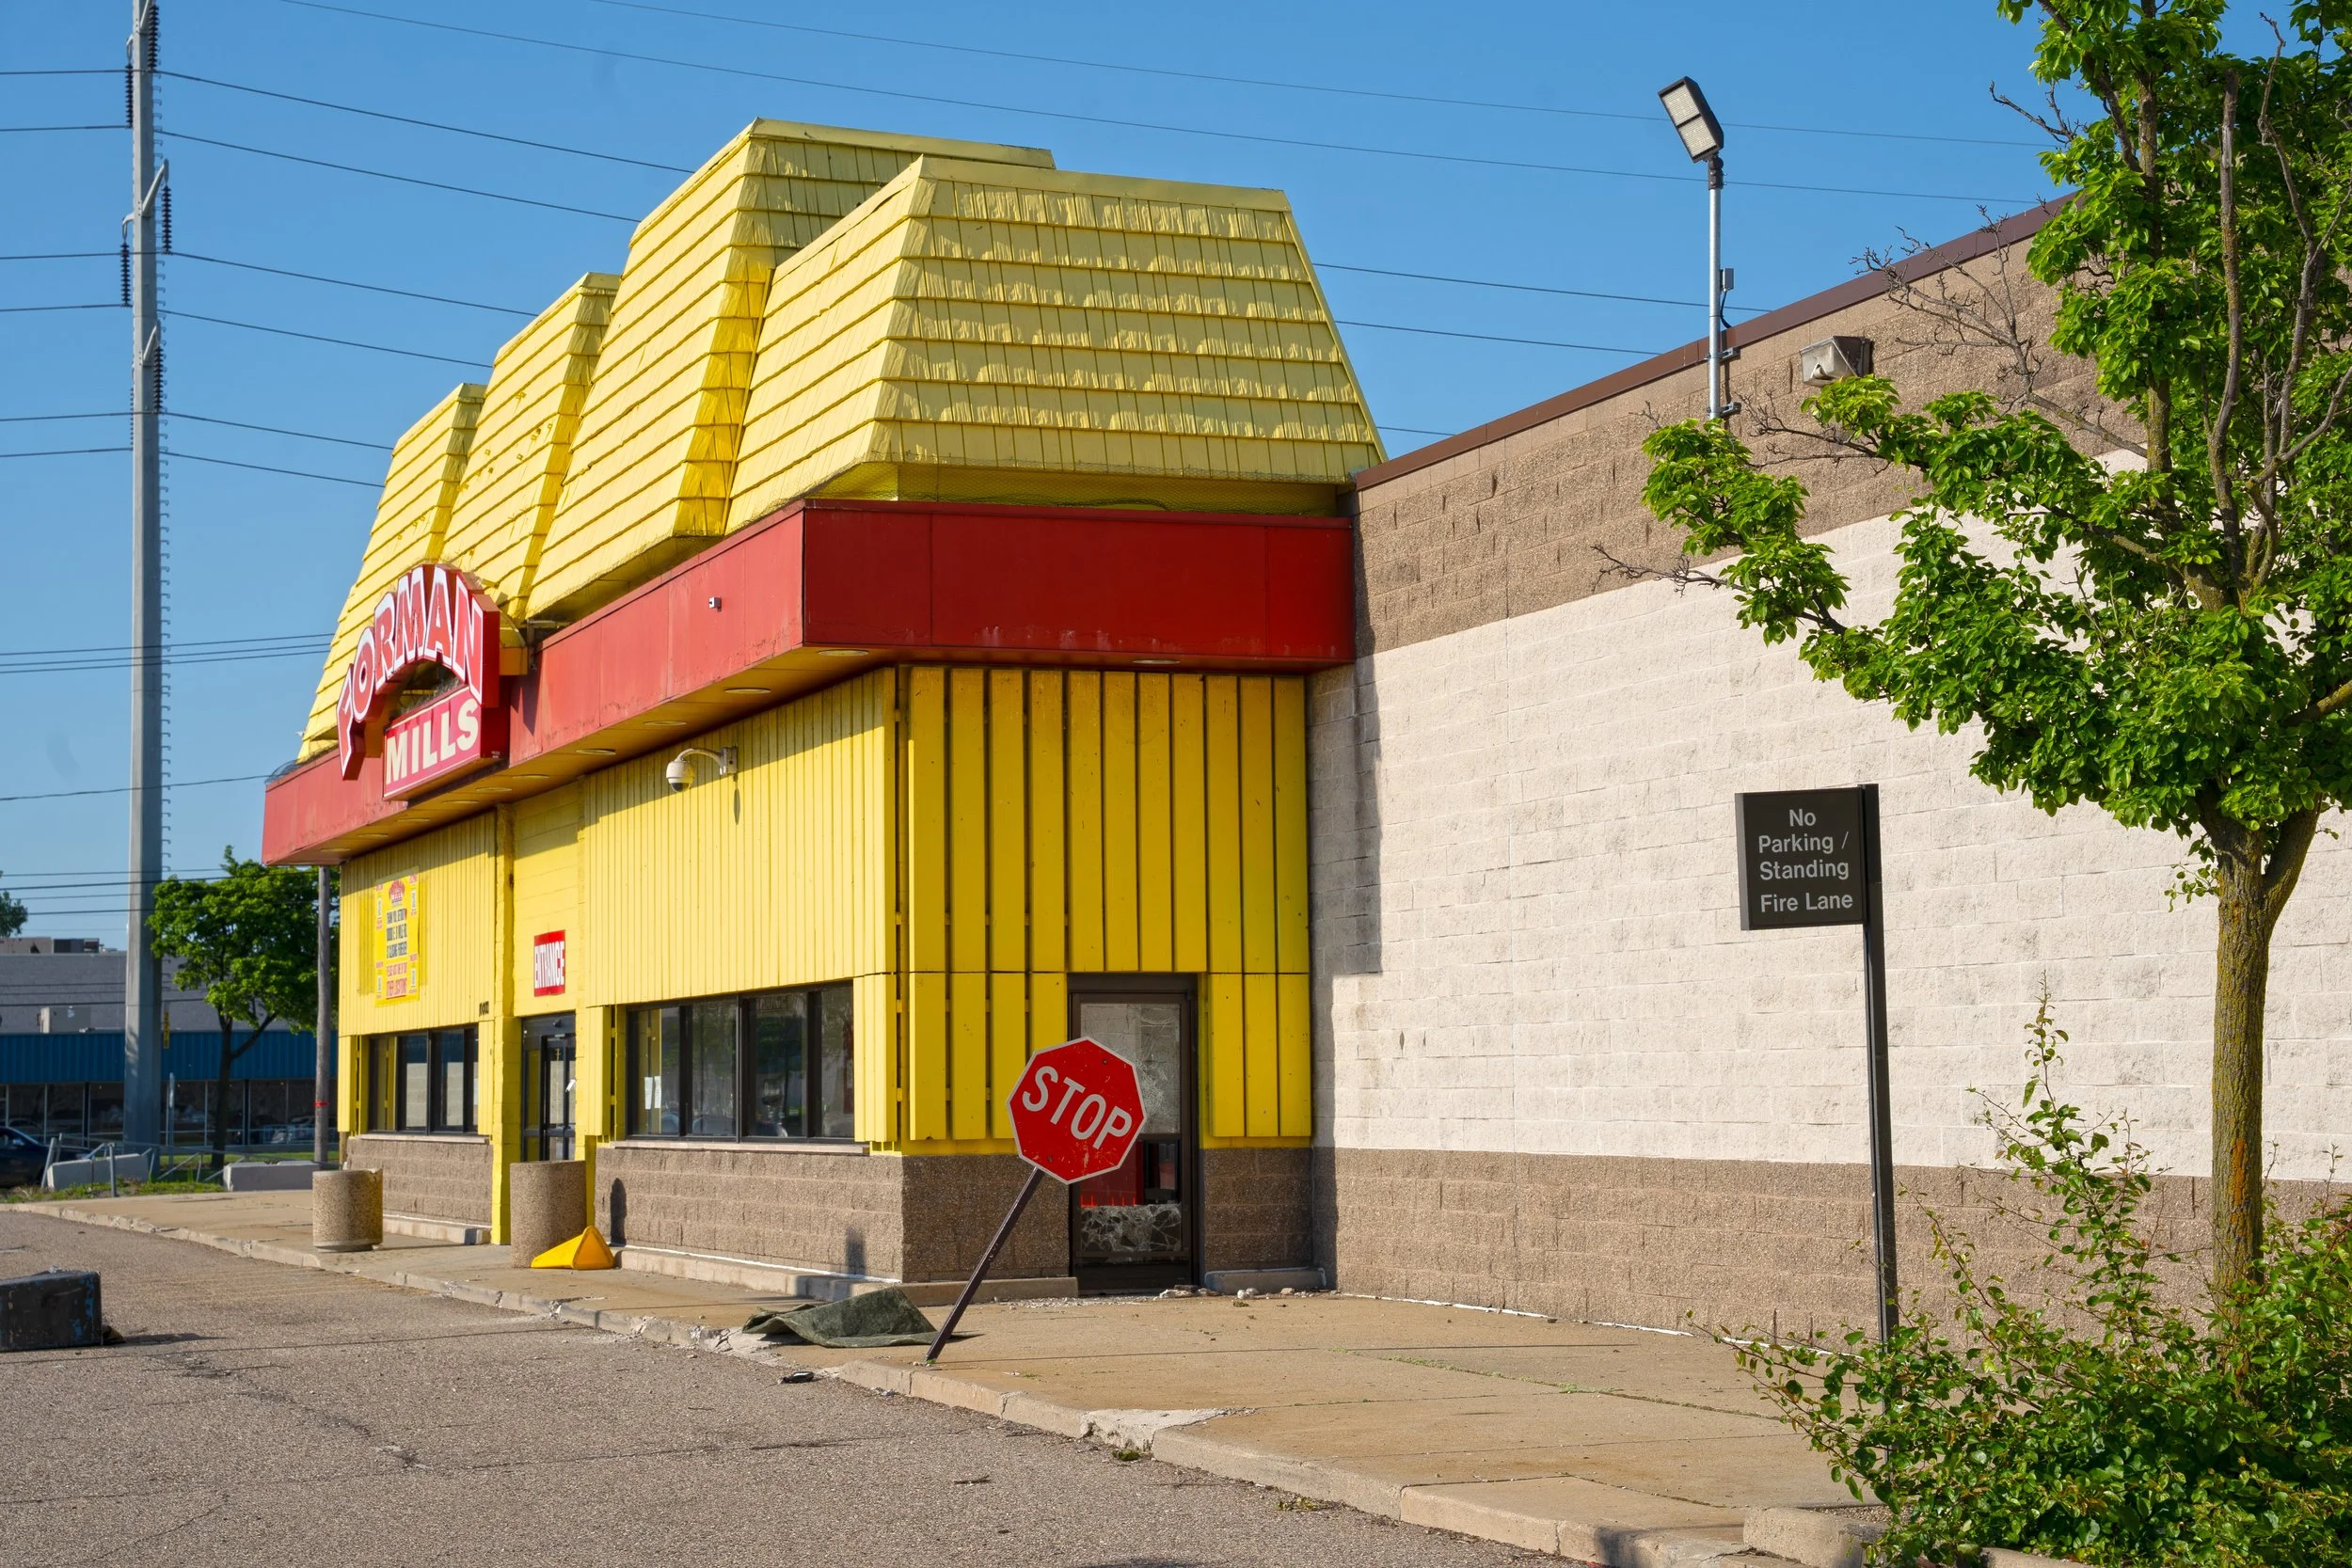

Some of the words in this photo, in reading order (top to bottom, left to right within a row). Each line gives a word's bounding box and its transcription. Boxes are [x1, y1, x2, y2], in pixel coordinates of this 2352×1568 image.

[337, 565, 483, 776] FORMAN
[386, 699, 479, 784] MILLS
[1789, 808, 1817, 827] No
[1758, 833, 1834, 854] Parking
[1759, 859, 1850, 880] Standing
[1760, 894, 1799, 913] Fire
[1805, 892, 1853, 911] Lane
[1022, 1066, 1133, 1149] STOP
